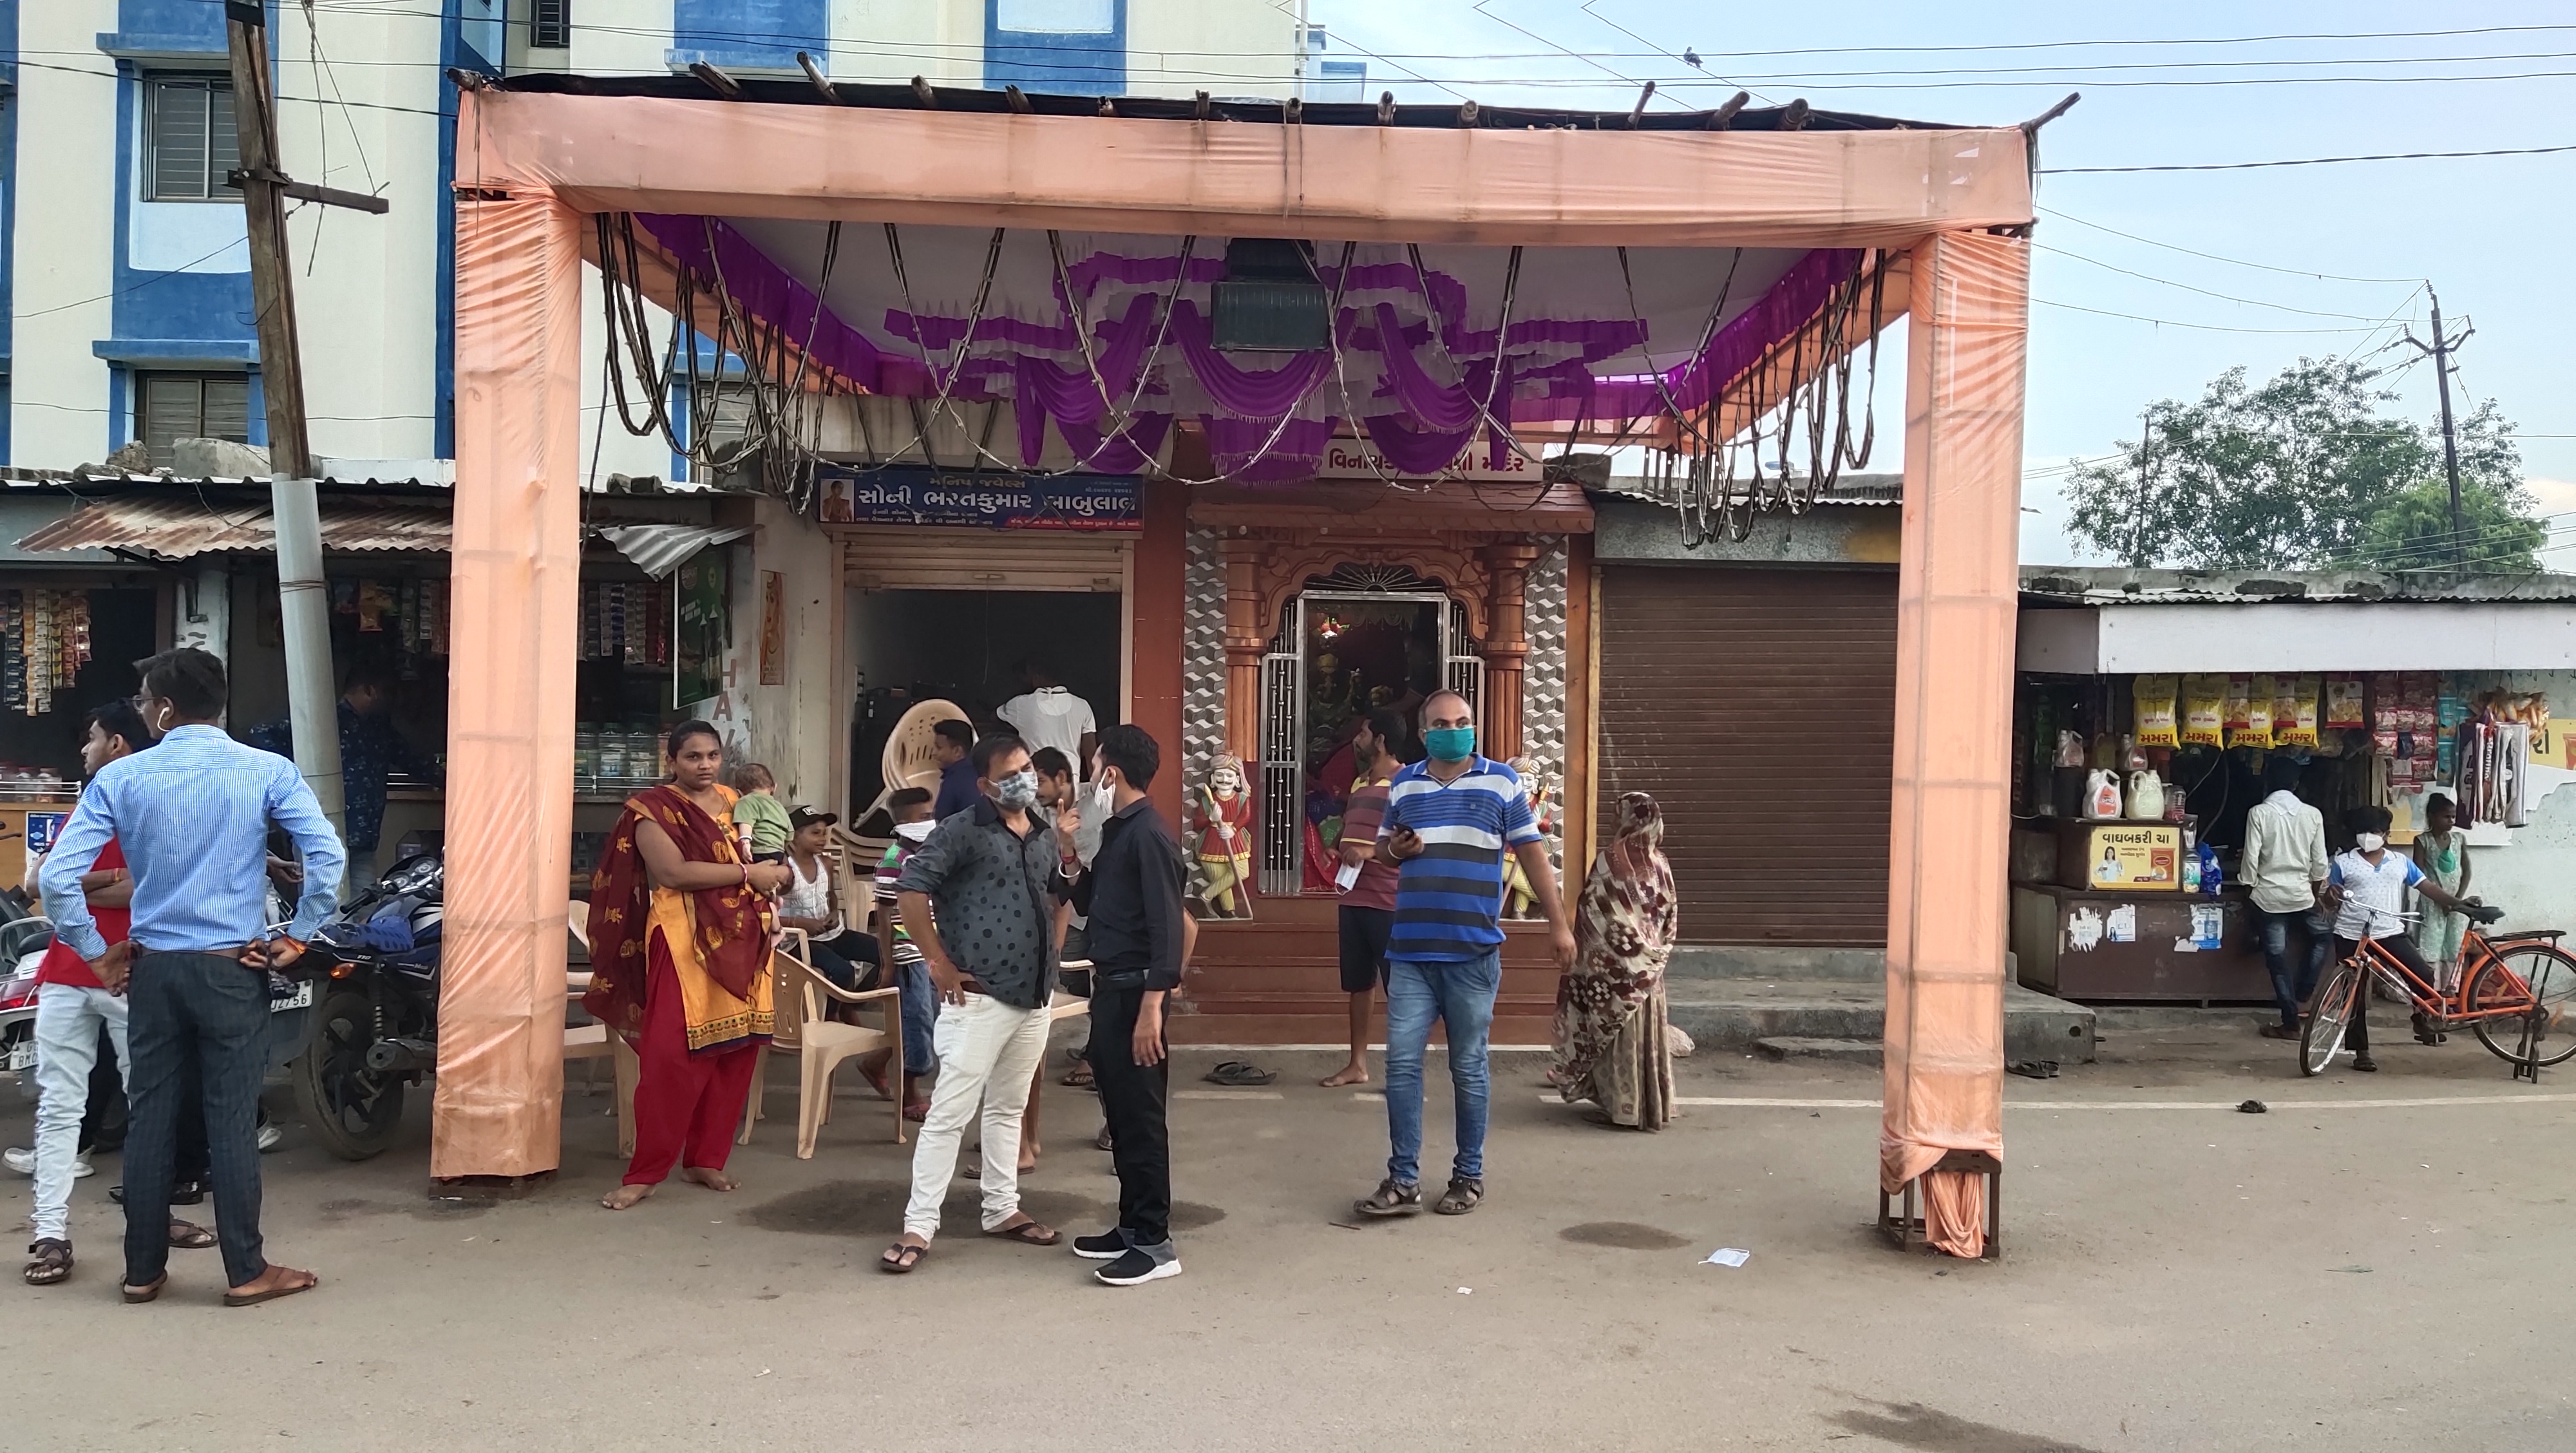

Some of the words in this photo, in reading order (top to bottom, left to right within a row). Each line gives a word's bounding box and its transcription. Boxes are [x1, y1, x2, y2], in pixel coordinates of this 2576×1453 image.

[858, 484, 912, 504] સોની
[923, 491, 1032, 513] ભરતકુમાર
[2140, 734, 2174, 743] મમરા
[2185, 732, 2219, 743] મમરા
[2235, 733, 2269, 743] મમરા
[2283, 732, 2315, 742] મમરા
[2102, 830, 2152, 844] વાઘબકરી
[2156, 834, 2170, 844] ચા
